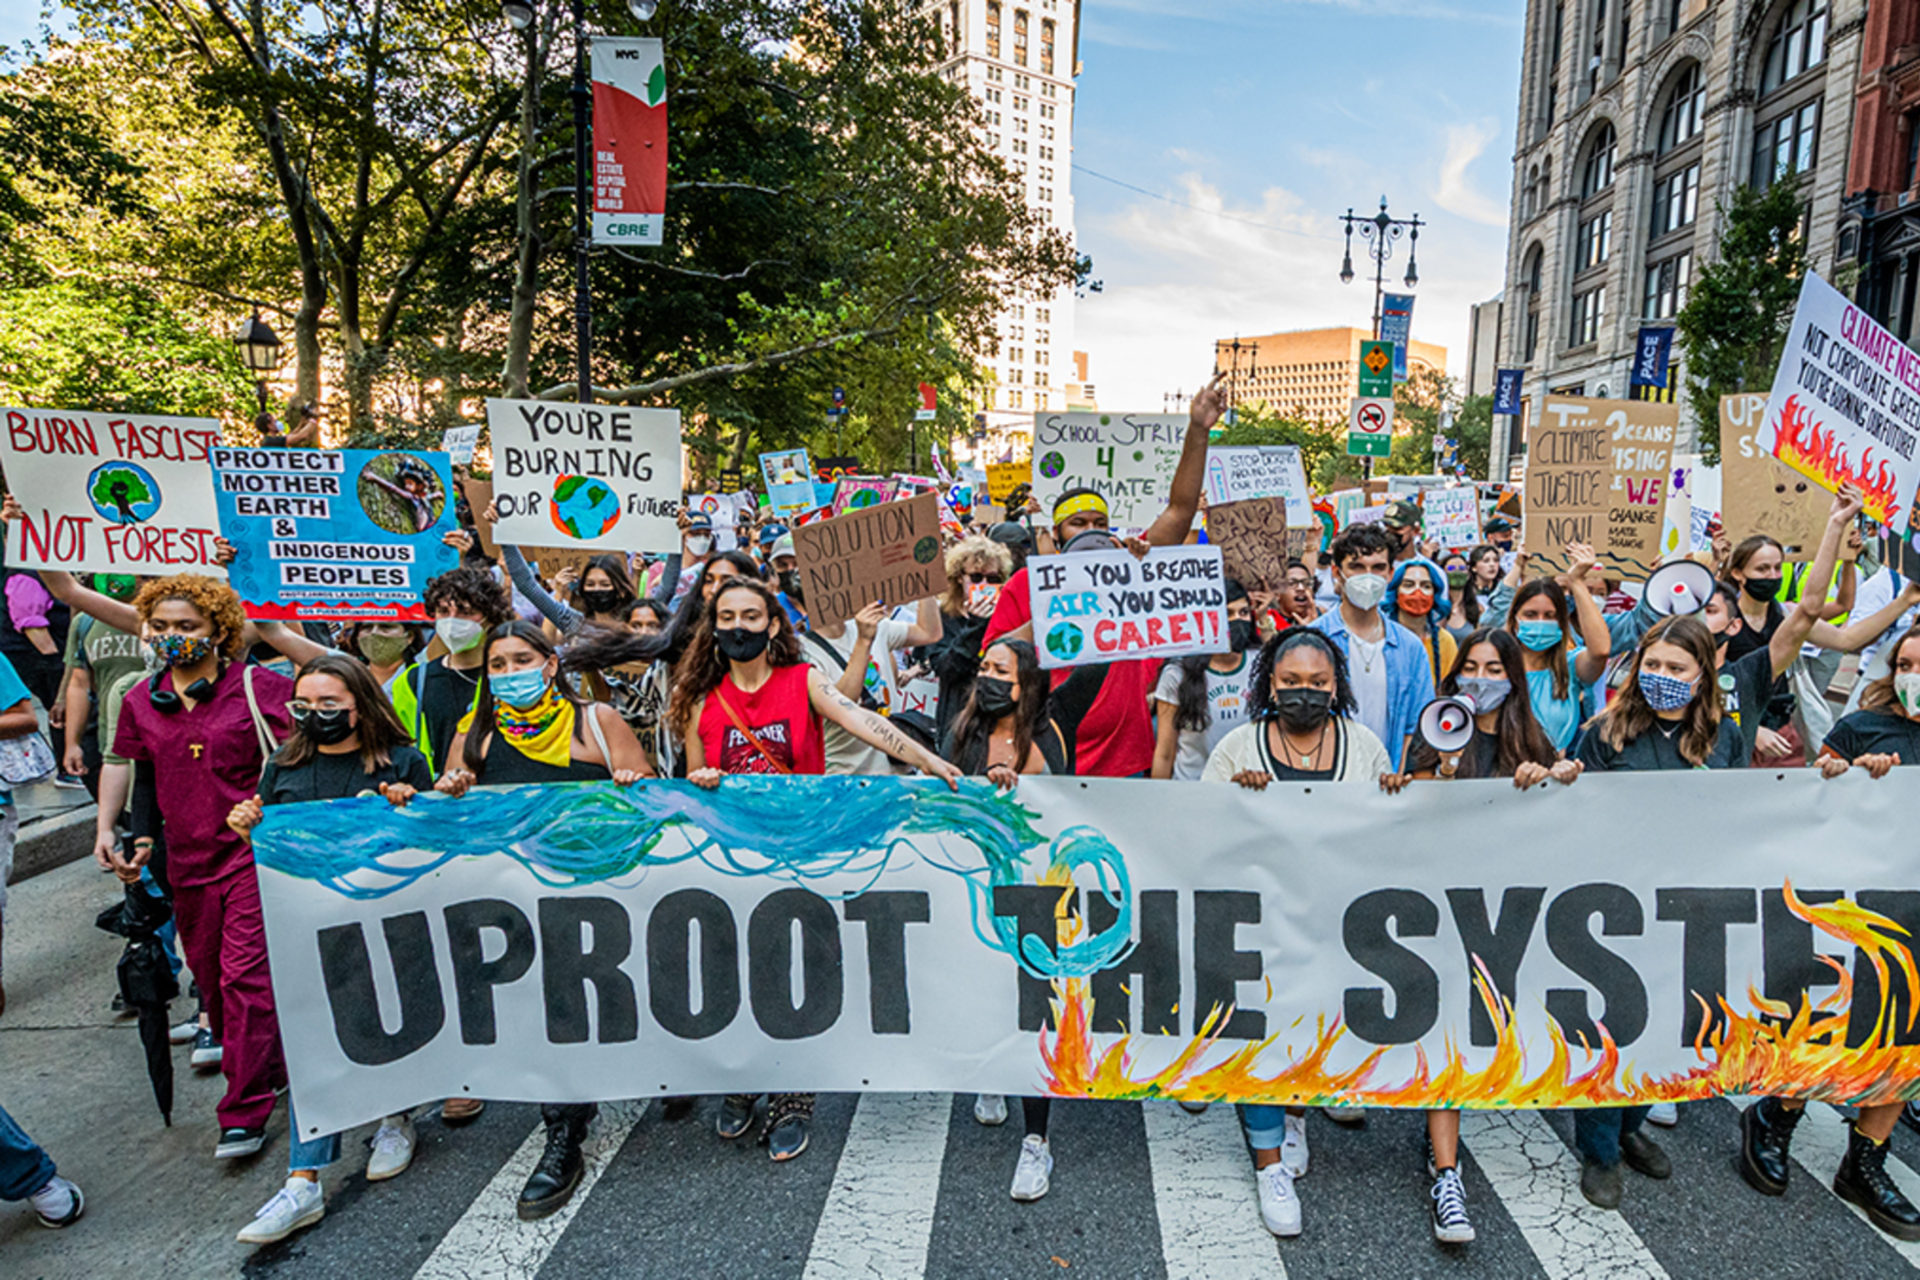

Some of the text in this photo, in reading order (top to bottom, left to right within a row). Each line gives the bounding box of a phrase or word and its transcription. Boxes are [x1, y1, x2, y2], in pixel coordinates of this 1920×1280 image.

[615, 49, 640, 60] NYC
[597, 151, 616, 163] REAL
[597, 164, 624, 175] ESTATE
[597, 176, 627, 187] CAPITAL
[597, 187, 622, 198] OF THE
[597, 199, 624, 210] WORLD
[606, 223, 650, 237] CBRE
[1841, 304, 1898, 373] CLIMATE
[1640, 335, 1660, 380] PACE
[1802, 321, 1830, 361] NOT
[1827, 340, 1892, 408] CORPORATE
[1498, 375, 1515, 409] PACE
[7, 411, 99, 456] BURN
[518, 405, 632, 442] YOU'RE
[1039, 413, 1185, 446] SCHOOL STRIK
[214, 450, 341, 471] PROTECT
[1536, 428, 1607, 465] CLIMATE
[1611, 446, 1667, 472] ISING
[505, 447, 654, 482] BURNING
[1096, 446, 1116, 479] 4
[1230, 454, 1260, 468] STOP
[223, 474, 339, 494] MOTHER
[1532, 469, 1602, 509] JUSTICE
[1626, 477, 1663, 506] WE
[237, 497, 327, 516] EARTH
[496, 491, 680, 519] OUR FUTURE
[1608, 508, 1658, 524] CHANGE
[20, 508, 94, 564] NOT
[275, 519, 296, 536] &
[802, 503, 915, 564] SOLUTION
[1608, 526, 1639, 537] MATE
[275, 543, 411, 561] INDIGENOUS
[285, 566, 406, 586] PEOPLES
[809, 556, 857, 595] NOT
[1036, 564, 1067, 592] IF
[1084, 562, 1132, 587] YOU
[1141, 558, 1219, 583] BREATHE
[815, 569, 930, 626] POLLUTION
[1159, 587, 1224, 611] SHOULD
[1093, 610, 1220, 652] CARE!!
[1220, 709, 1238, 720] DAY
[865, 717, 907, 754] CLIMATE
[316, 887, 931, 1067] UPROOT
[993, 884, 1268, 1041] THE
